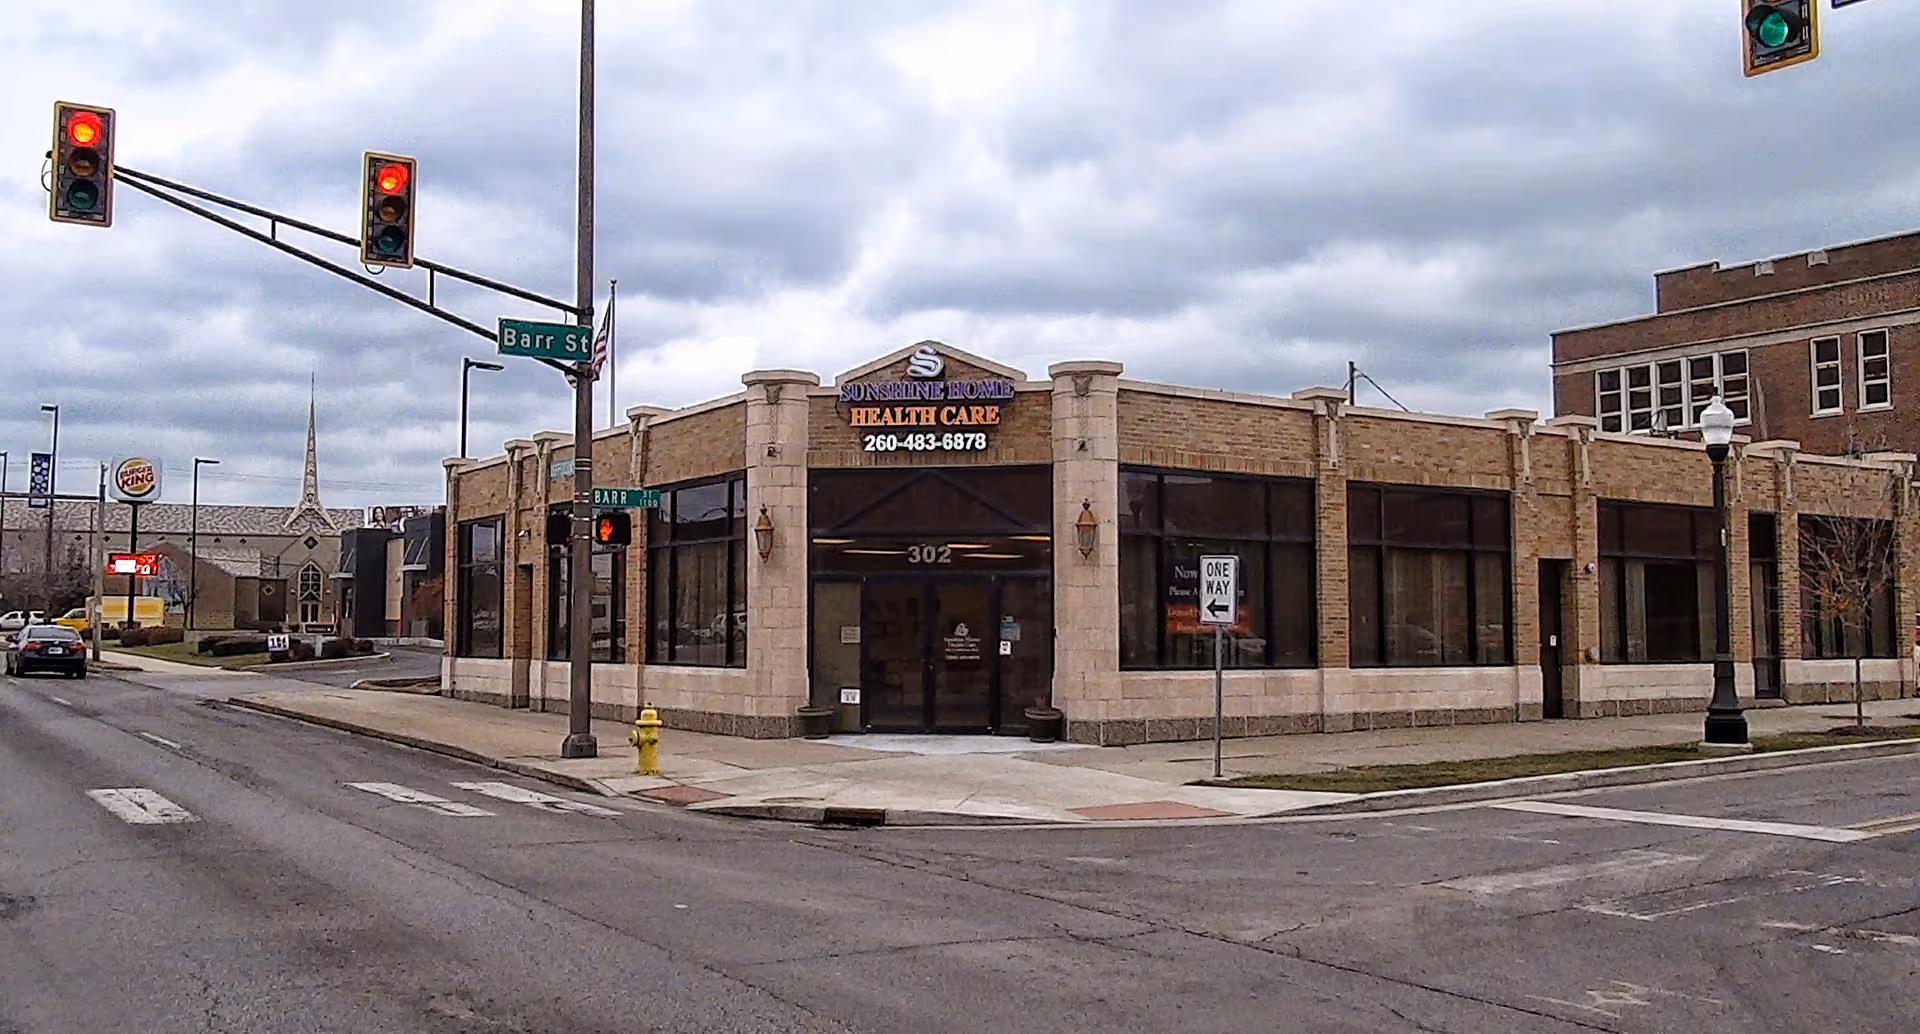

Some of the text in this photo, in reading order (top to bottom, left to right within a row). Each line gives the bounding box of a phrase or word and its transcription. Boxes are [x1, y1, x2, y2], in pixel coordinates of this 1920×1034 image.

[503, 327, 589, 353] Barr St
[840, 379, 1015, 401] SUNSHINE HOME
[850, 406, 1000, 426] HEALTH CARE
[864, 433, 987, 451] 260-483-6878
[120, 465, 153, 479] BURGER
[121, 472, 154, 490] KING
[594, 490, 627, 505] BARR
[907, 545, 951, 564] 302
[1174, 565, 1198, 579] Now
[1206, 562, 1230, 577] ONE
[1206, 580, 1230, 595] WAY
